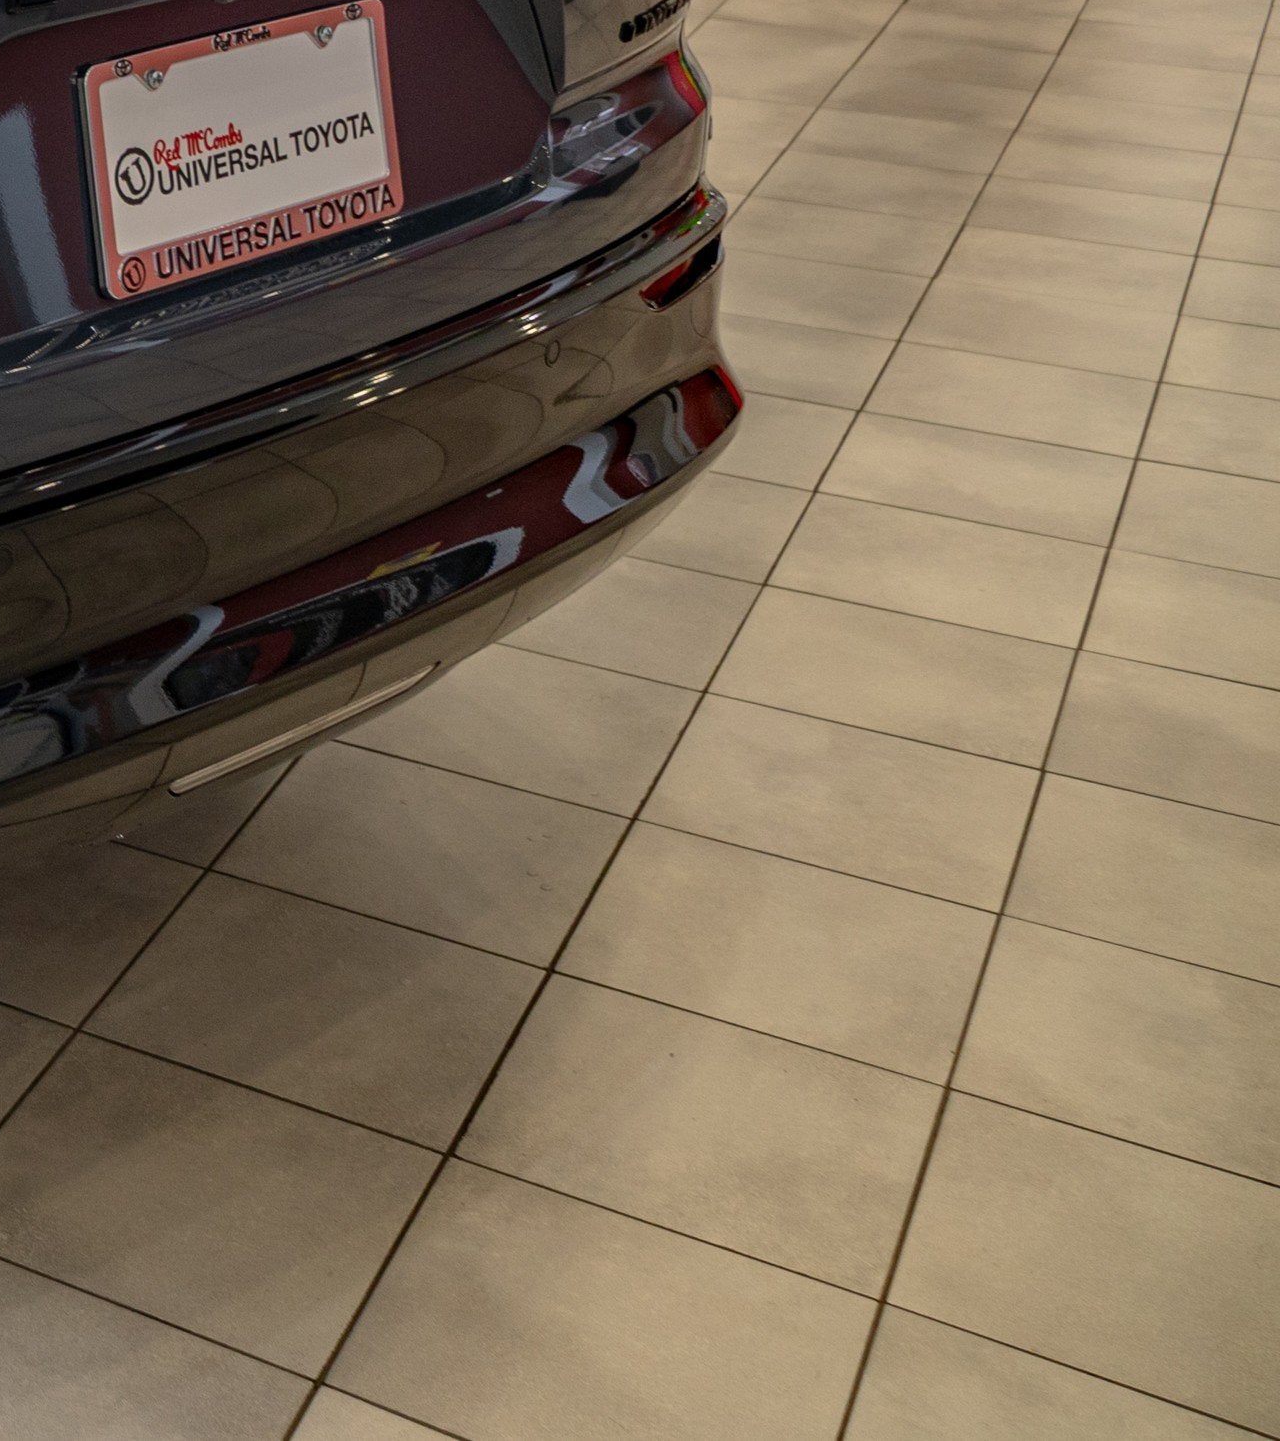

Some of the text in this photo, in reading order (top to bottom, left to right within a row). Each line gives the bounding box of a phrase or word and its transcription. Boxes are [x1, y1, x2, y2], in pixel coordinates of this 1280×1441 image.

[153, 137, 182, 171] Red
[158, 111, 374, 195] UNIVERSAL TOYOTA
[153, 214, 301, 279] UNIVERSAL
[302, 184, 395, 233] TOYOTA
